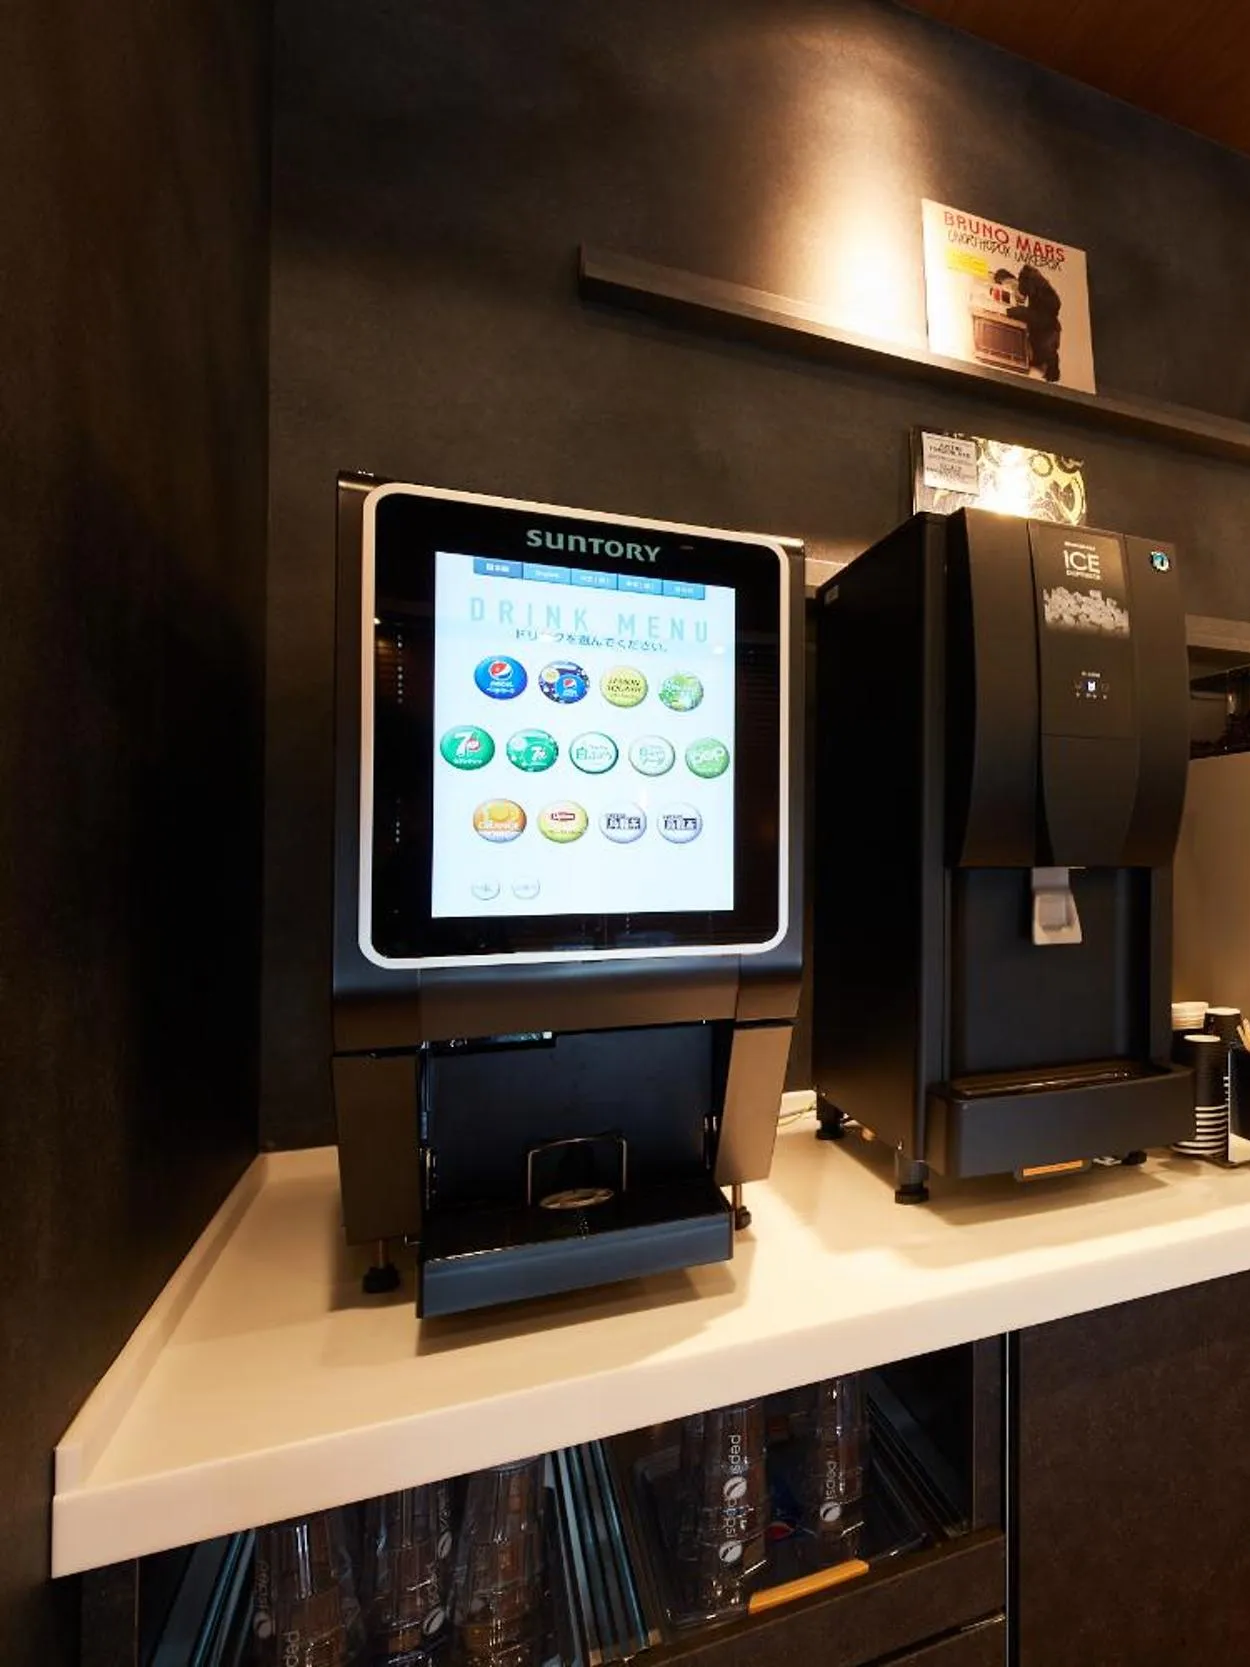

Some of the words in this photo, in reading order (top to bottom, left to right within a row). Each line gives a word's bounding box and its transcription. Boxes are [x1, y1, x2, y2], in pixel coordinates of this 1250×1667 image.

[944, 211, 1009, 244] BRUNO
[1016, 236, 1065, 263] MARS
[526, 529, 661, 562] SUNTORY
[1063, 549, 1101, 574] ICE
[469, 597, 589, 632] DRINK
[617, 612, 708, 643] MENU
[515, 628, 668, 653] ドリクを選んでください。
[728, 1434, 741, 1475] pepsi
